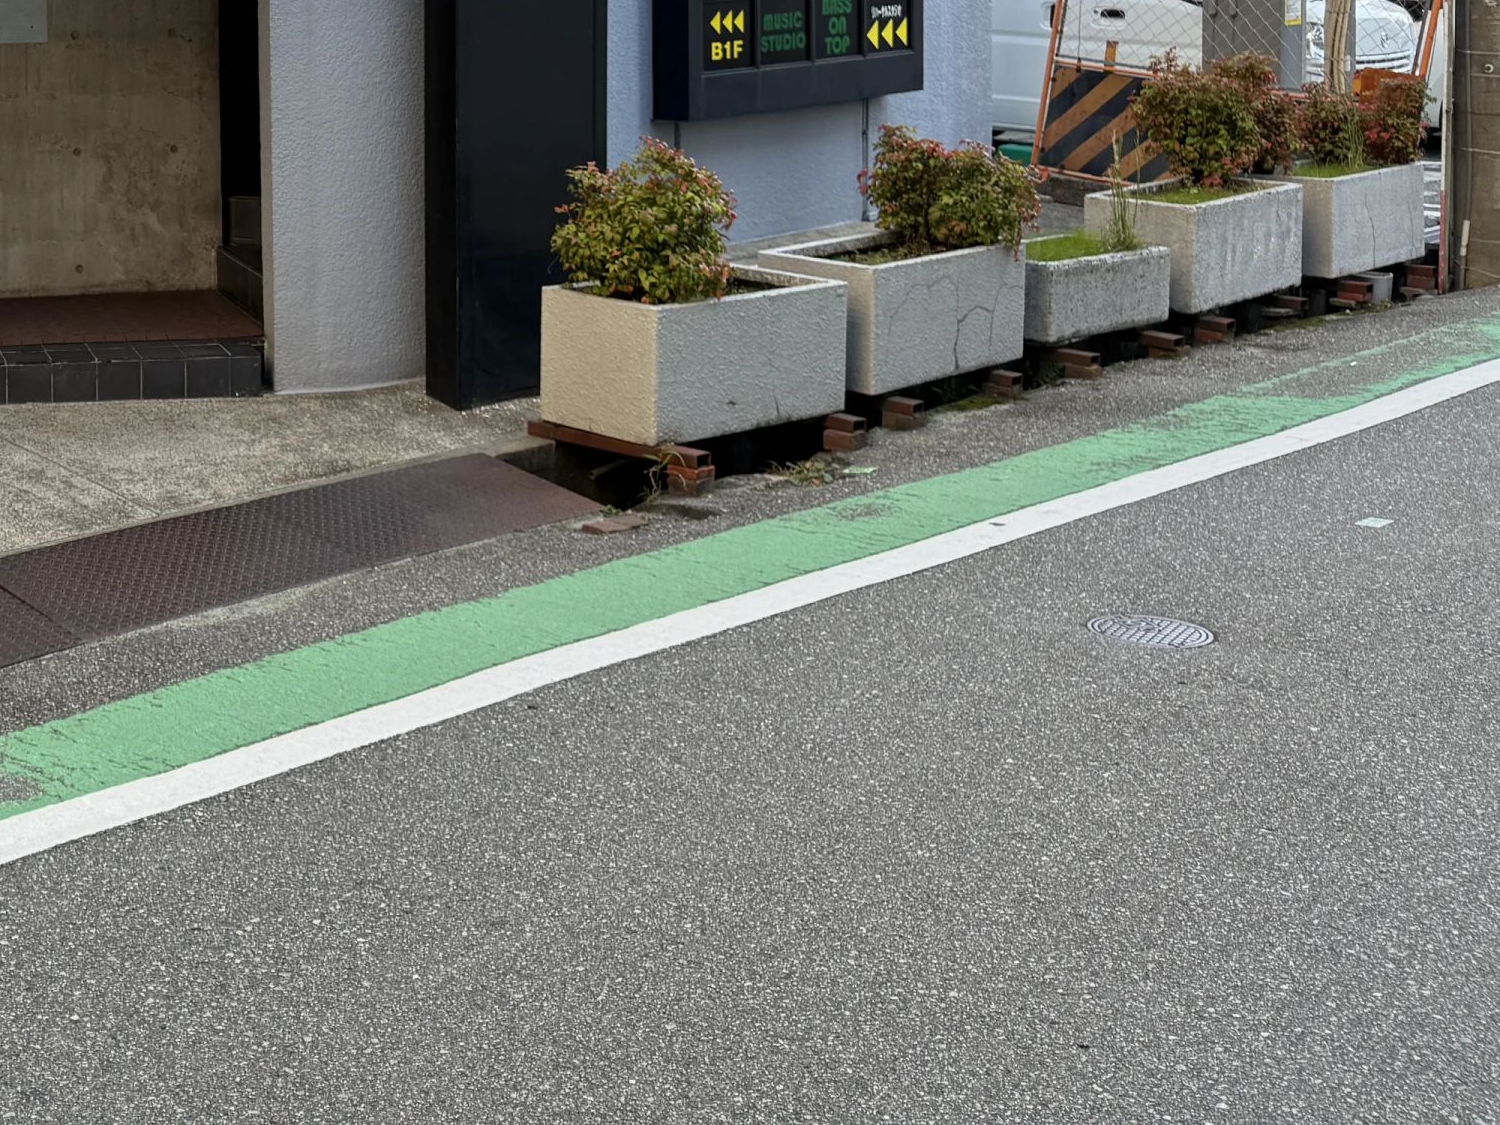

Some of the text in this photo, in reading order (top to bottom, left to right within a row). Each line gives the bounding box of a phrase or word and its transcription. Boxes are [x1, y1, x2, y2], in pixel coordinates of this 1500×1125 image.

[763, 11, 804, 31] MUSIC
[711, 40, 744, 61] B1F
[761, 33, 807, 53] STUDIO
[825, 35, 851, 55] TOP
